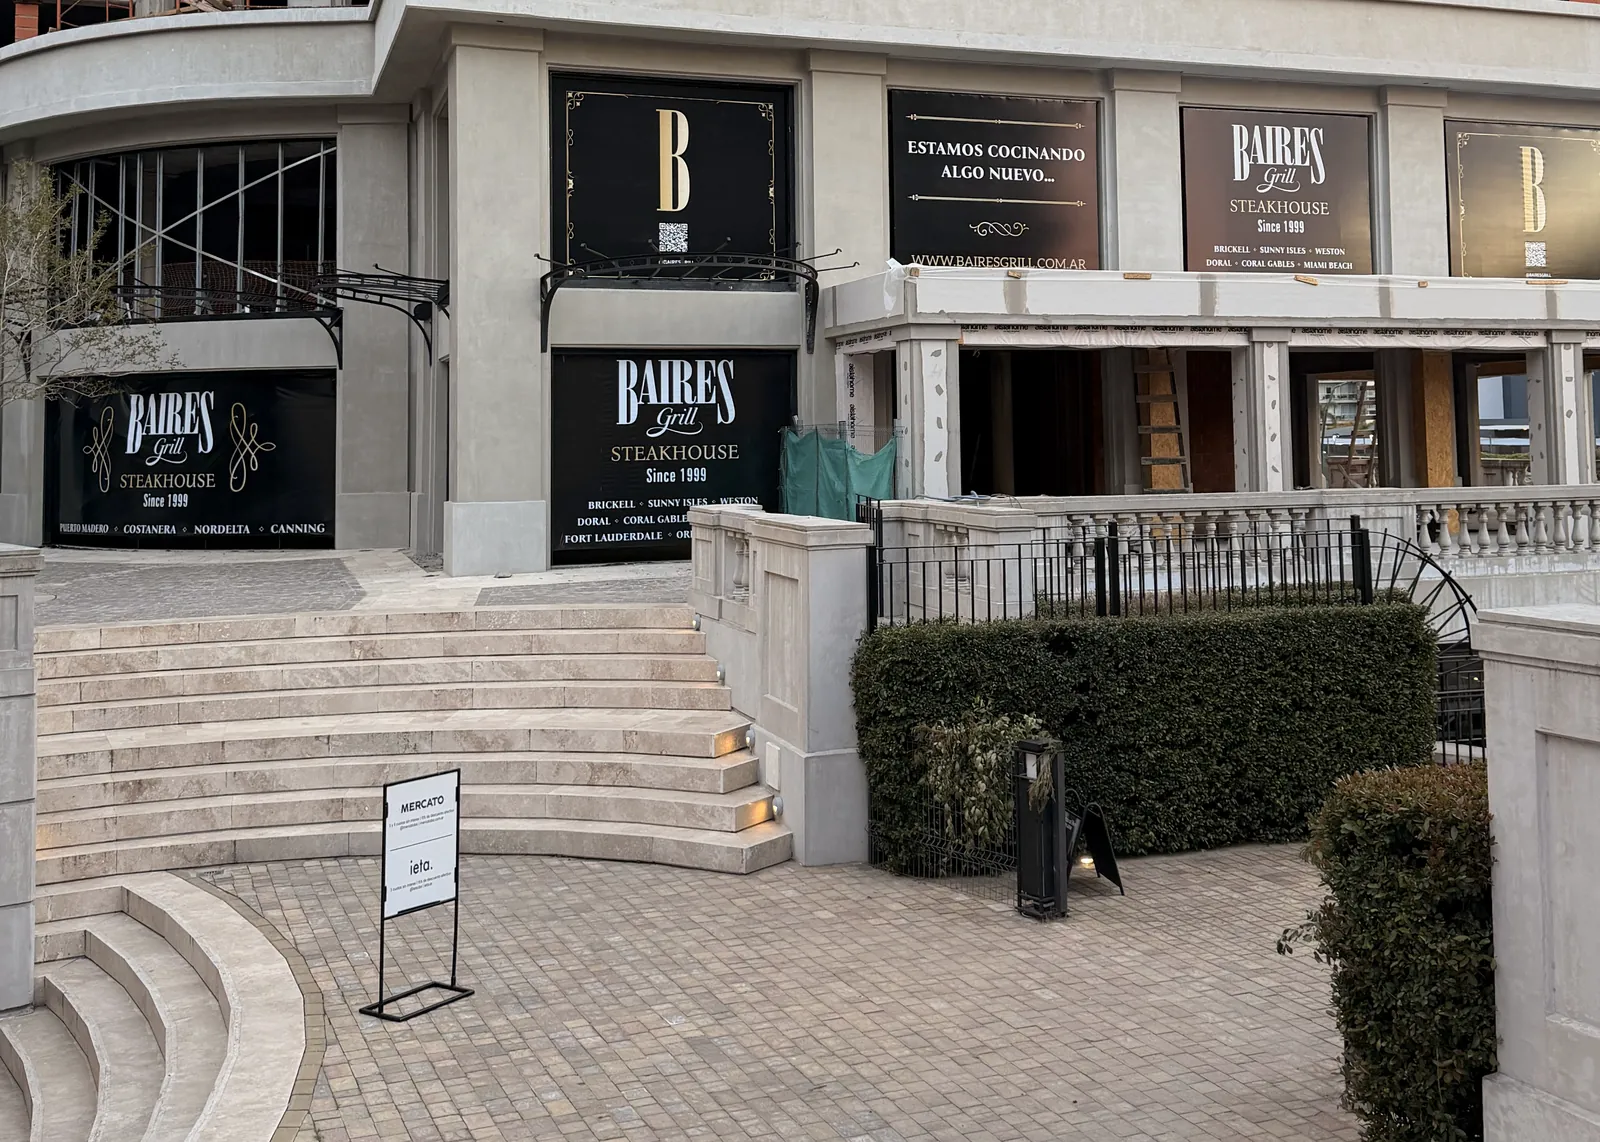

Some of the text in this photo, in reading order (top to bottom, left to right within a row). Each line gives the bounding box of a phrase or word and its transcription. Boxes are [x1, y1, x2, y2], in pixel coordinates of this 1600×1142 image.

[907, 140, 1086, 162] ESTAMOS COCINANDO
[1231, 124, 1326, 185] BAIRES
[656, 109, 691, 211] B
[941, 164, 1055, 183] ALGO NUEVO...
[1255, 167, 1301, 193] Grill
[1519, 146, 1546, 233] B
[1230, 199, 1329, 215] STEAKHOUSE
[1257, 219, 1305, 234] Since 1999
[1213, 245, 1346, 256] BRICKELL SUNNY ISLES WESTON
[911, 254, 1087, 270] WWW.BAIRESGRILL.COM.AR
[1206, 259, 1353, 271] DORAL CORAL GABLES MIAMI BEACH
[616, 359, 736, 425] BAIRES
[125, 391, 215, 454] BAIRES
[646, 407, 704, 438] Grill
[145, 437, 188, 466] Grill
[610, 444, 740, 462] STEAKHOUSE
[119, 473, 216, 489] STEAKHOUSE
[646, 467, 707, 483] Since 1999
[143, 494, 188, 508] Since 1999
[588, 497, 759, 510] BRICKELL SUNNY ISLES WESTON
[59, 523, 326, 534] PUERTO MADERO COSTANERA NORDELTA CANNING
[577, 514, 688, 527] DORAL CORAL GABLE
[564, 534, 593, 544] FORT
[594, 532, 663, 543] LAUDERDALE
[400, 795, 445, 814] MERCATO
